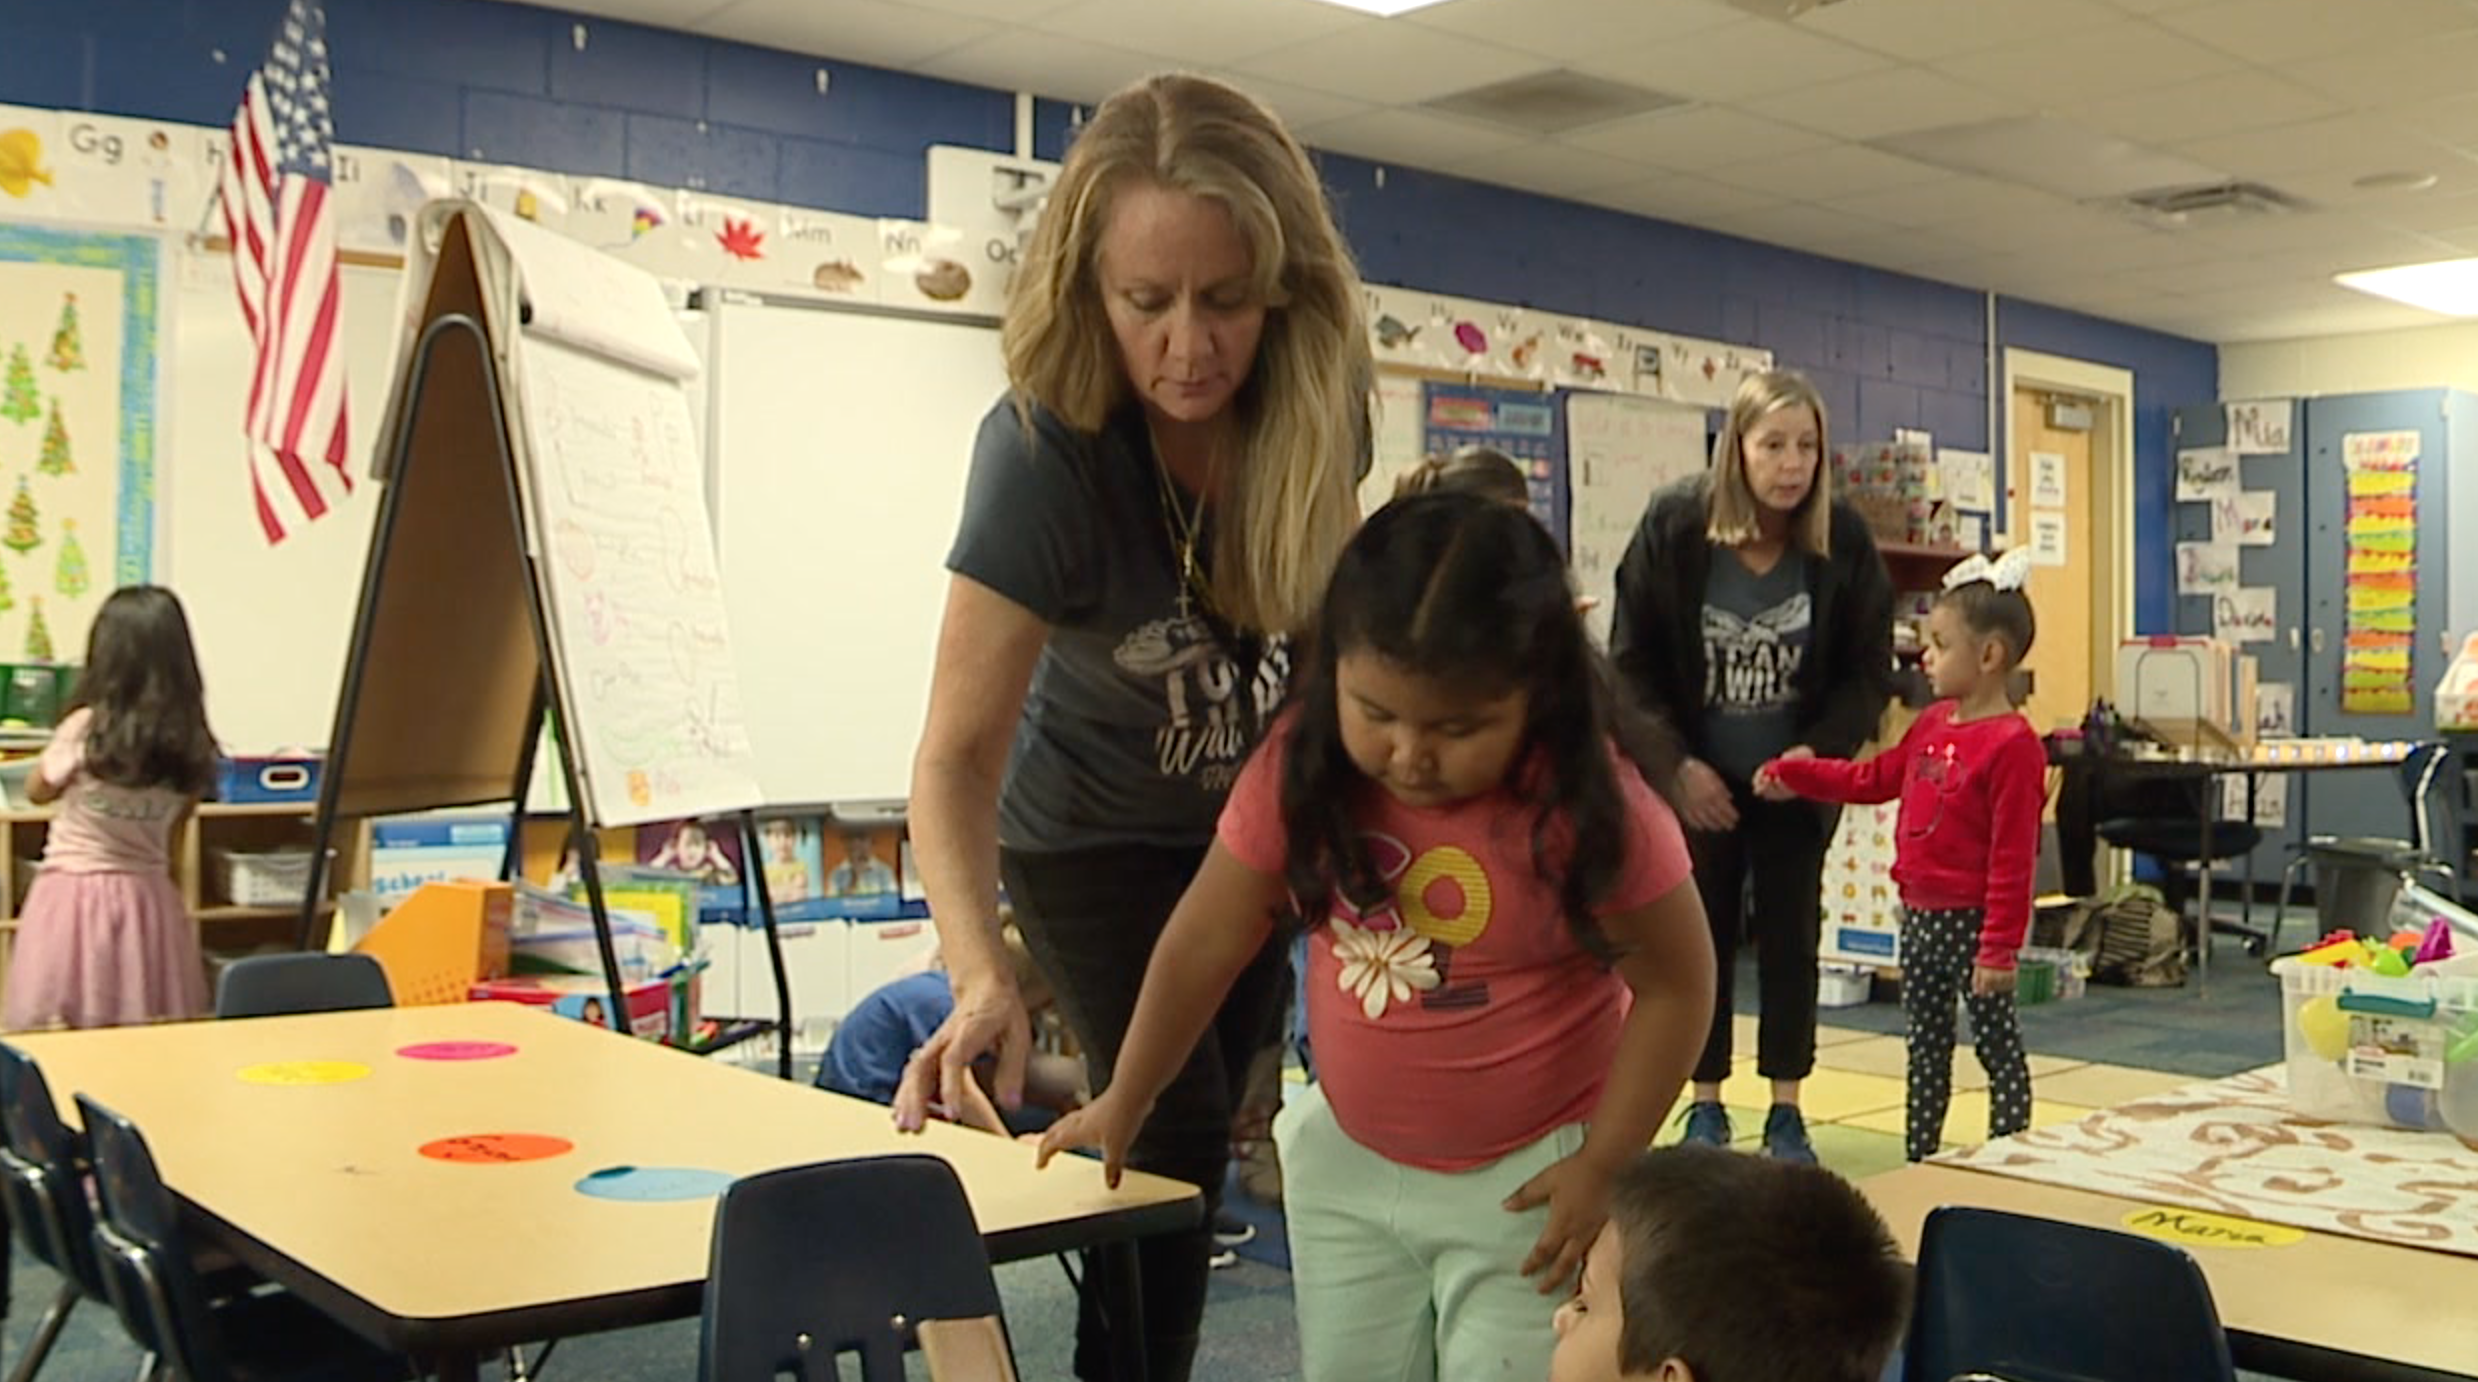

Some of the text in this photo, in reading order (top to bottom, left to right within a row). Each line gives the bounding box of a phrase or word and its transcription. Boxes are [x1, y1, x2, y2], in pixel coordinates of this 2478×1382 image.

[69, 123, 124, 166] Gg
[338, 155, 360, 182] Ii
[885, 231, 922, 252] Nn
